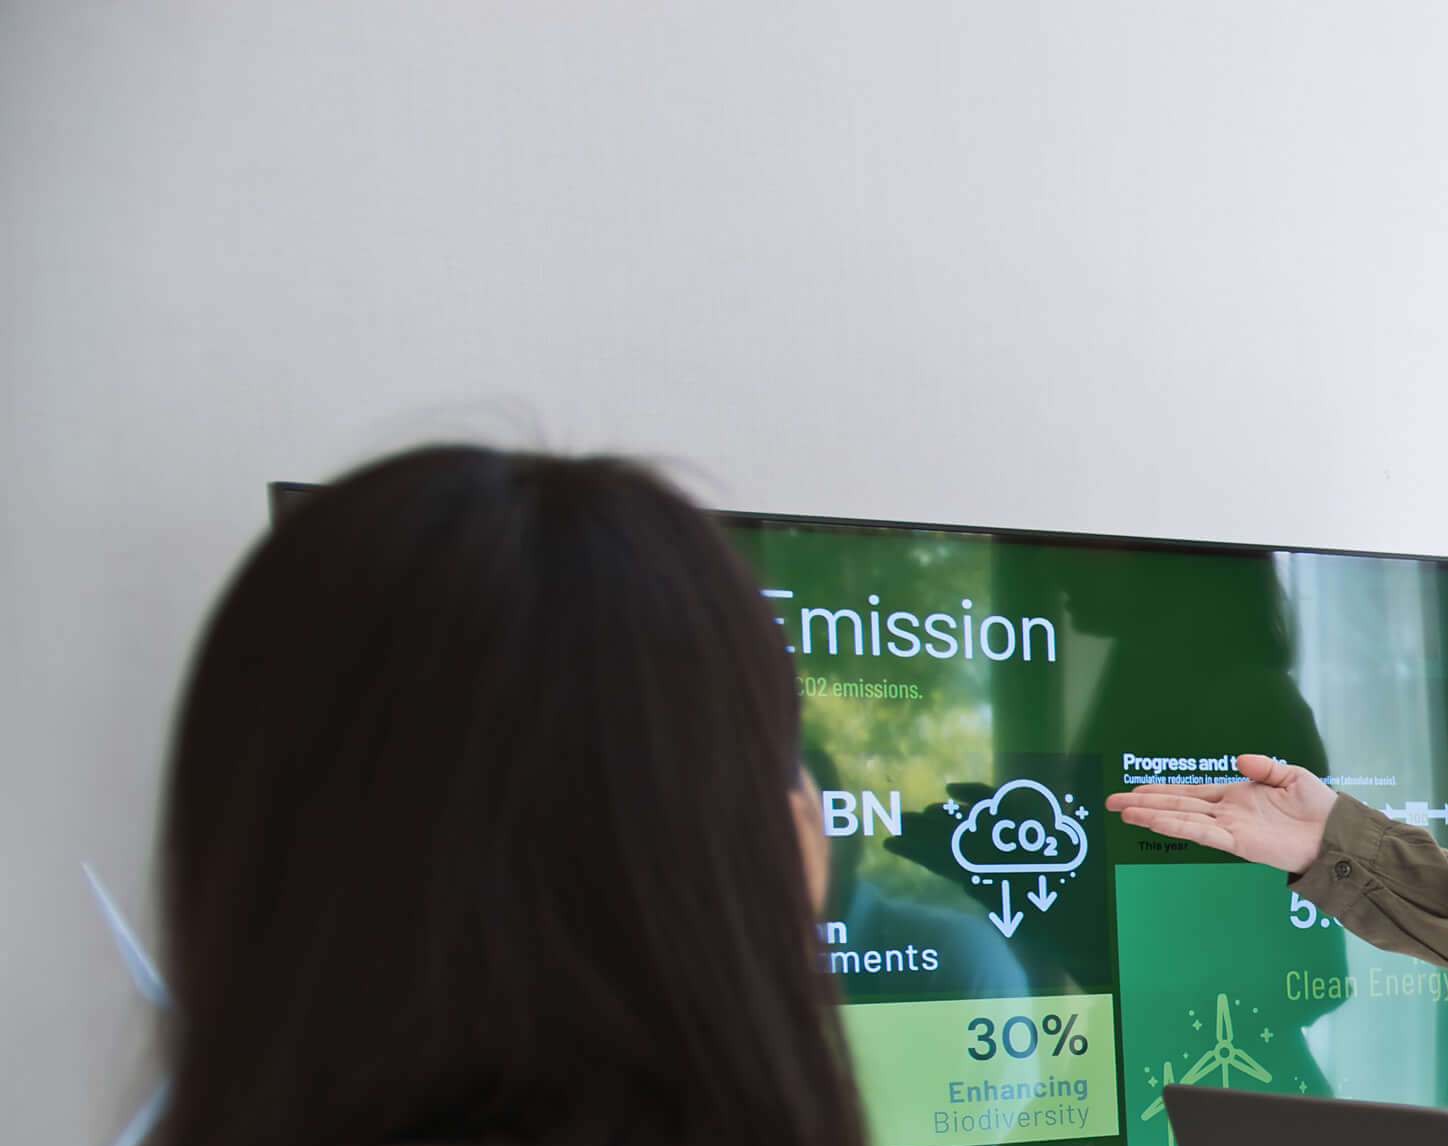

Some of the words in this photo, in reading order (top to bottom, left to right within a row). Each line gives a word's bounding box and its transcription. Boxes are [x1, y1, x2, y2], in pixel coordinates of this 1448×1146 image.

[832, 677, 923, 700] emissions.
[1123, 753, 1197, 774] Progress
[1199, 755, 1229, 771] and
[1123, 773, 1166, 784] Cumulative
[1168, 774, 1203, 784] reduction
[1205, 774, 1213, 784] in
[822, 790, 902, 836] BN
[1290, 891, 1344, 928] 5.
[1286, 971, 1357, 1000] Clean
[966, 1014, 1089, 1062] 30%
[949, 1075, 1089, 1104] Enhancing
[934, 1103, 1089, 1134] Biodiversity
